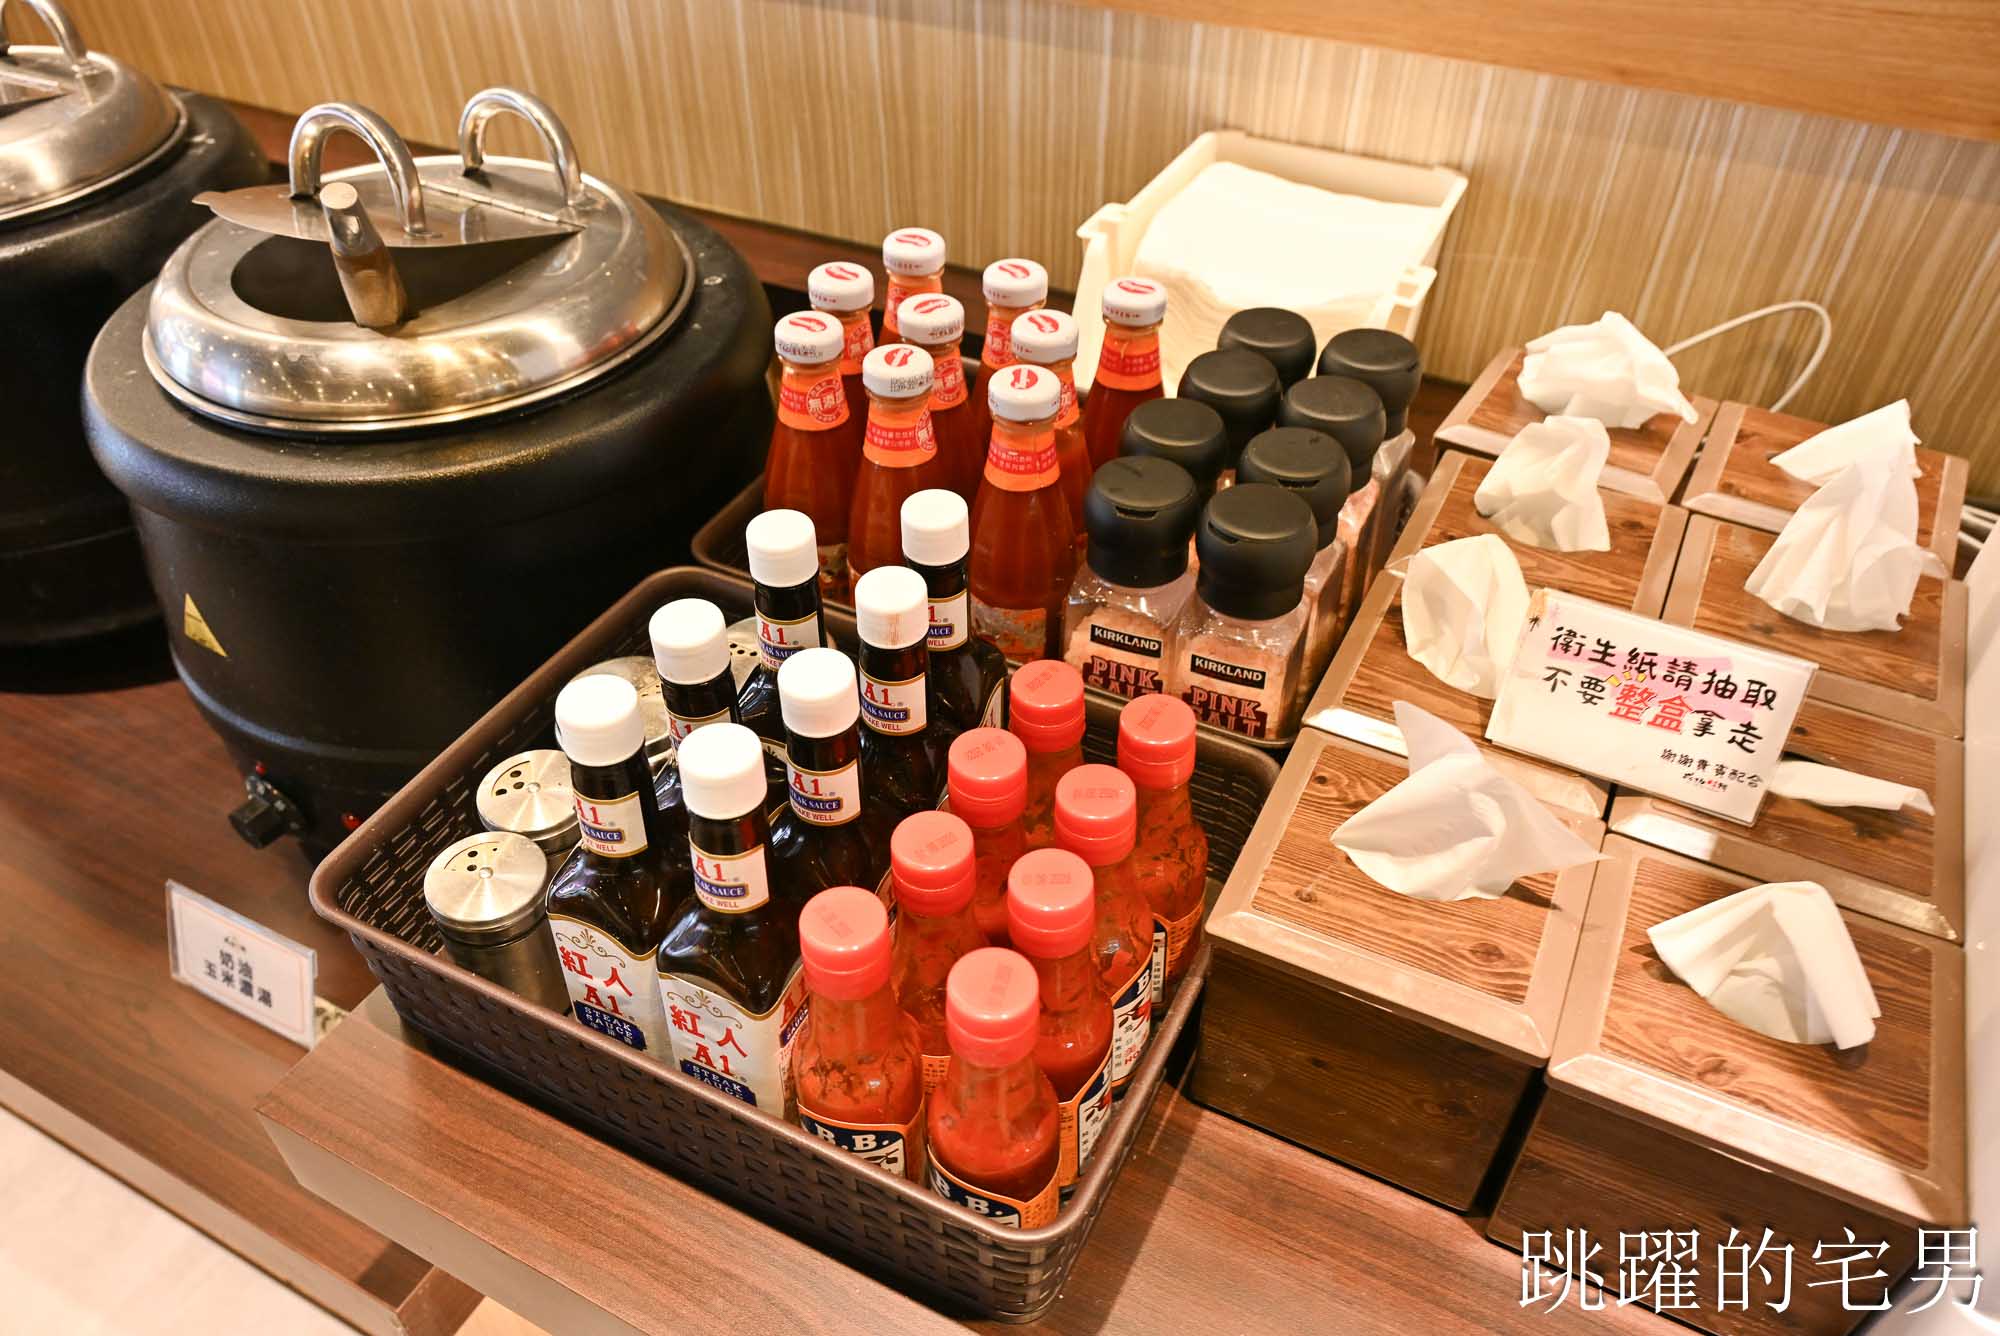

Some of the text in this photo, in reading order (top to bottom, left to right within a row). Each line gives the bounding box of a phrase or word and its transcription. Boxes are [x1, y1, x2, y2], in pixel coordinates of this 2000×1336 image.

[928, 627, 951, 636] AUCE
[1094, 627, 1159, 651] KIRKLAND
[1091, 656, 1159, 689] PINK
[1195, 657, 1262, 682] KIRKLAND
[1550, 625, 1778, 712] 衛生紙請抽取
[878, 710, 906, 719] SAUCE
[1191, 686, 1261, 720] PINK
[1542, 665, 1764, 754] 不要整盒拿走
[881, 723, 902, 731] WELL
[808, 799, 839, 810] SAUCE
[811, 813, 835, 821] WELL
[590, 830, 621, 840] SAUCE
[711, 887, 745, 897] SAUCE
[560, 946, 633, 997] 紅人
[584, 1006, 632, 1032] STEAK
[585, 1013, 633, 1040] SAUCE
[669, 1004, 748, 1058] 紅人
[692, 1065, 742, 1093] STEAK
